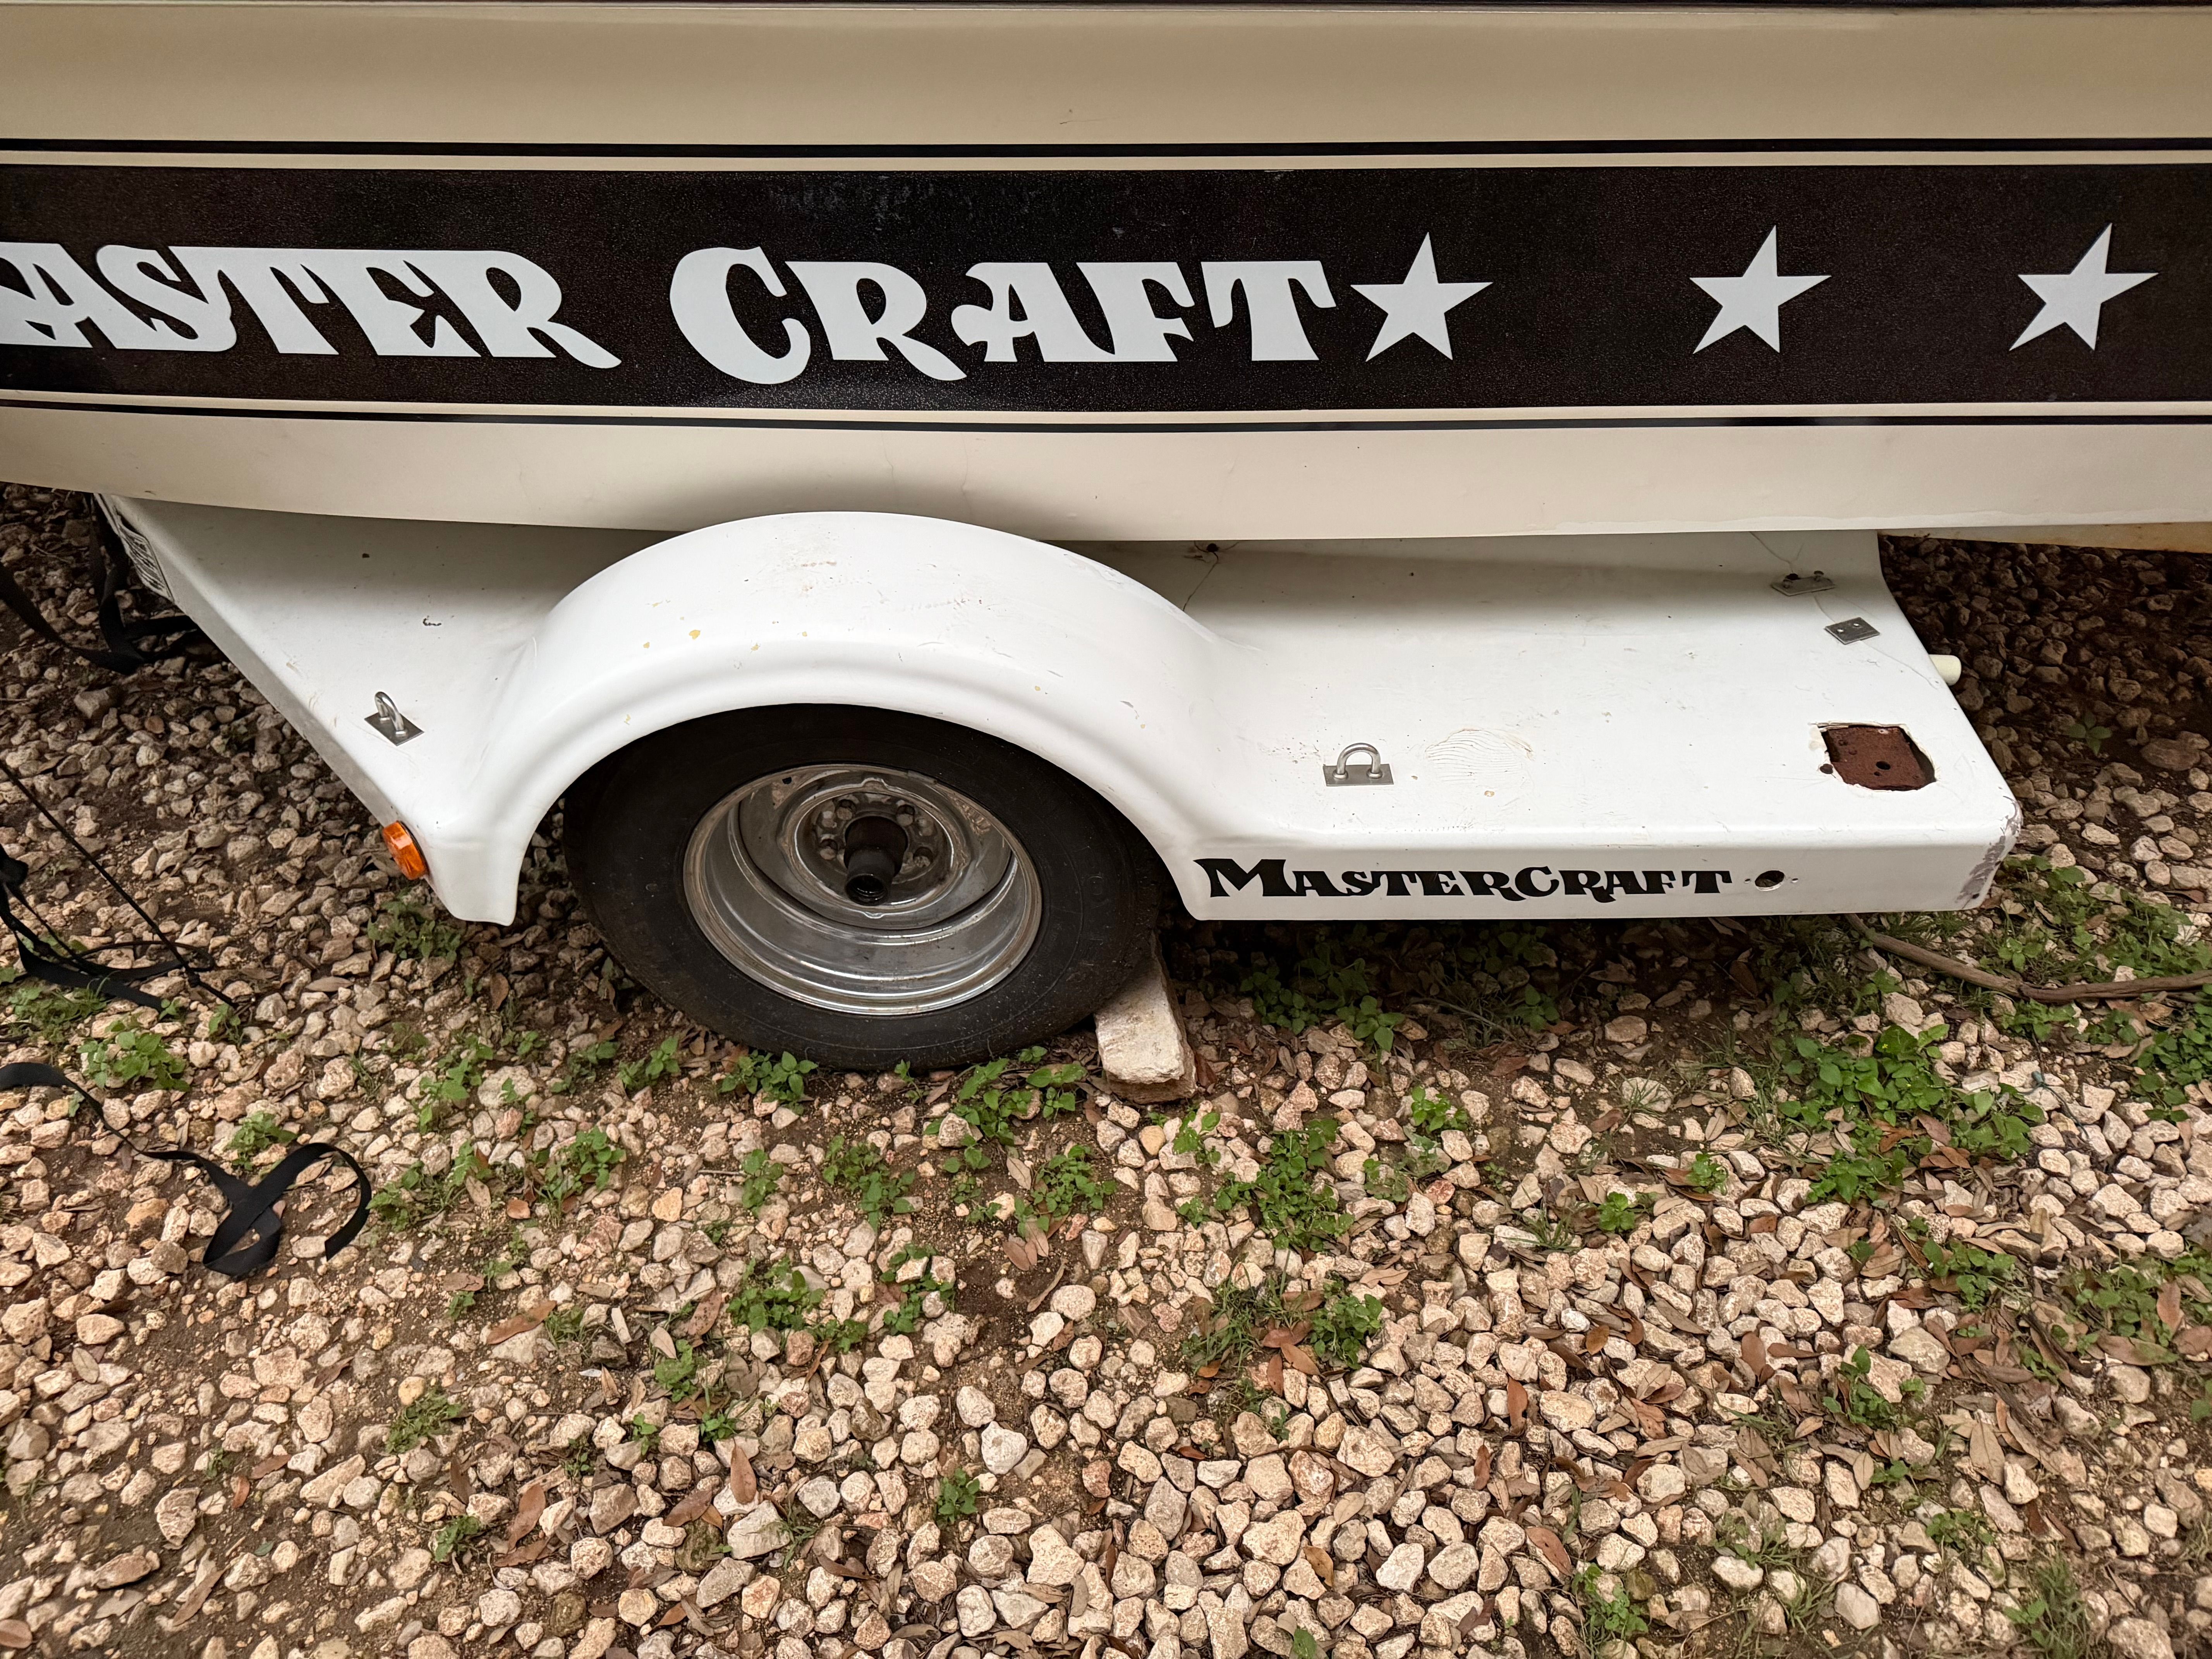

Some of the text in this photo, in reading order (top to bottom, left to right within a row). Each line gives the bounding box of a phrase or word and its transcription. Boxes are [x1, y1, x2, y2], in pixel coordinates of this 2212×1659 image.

[0, 242, 1336, 384] ASTER CRAFT
[1194, 858, 1733, 903] MASTERCRAFT
